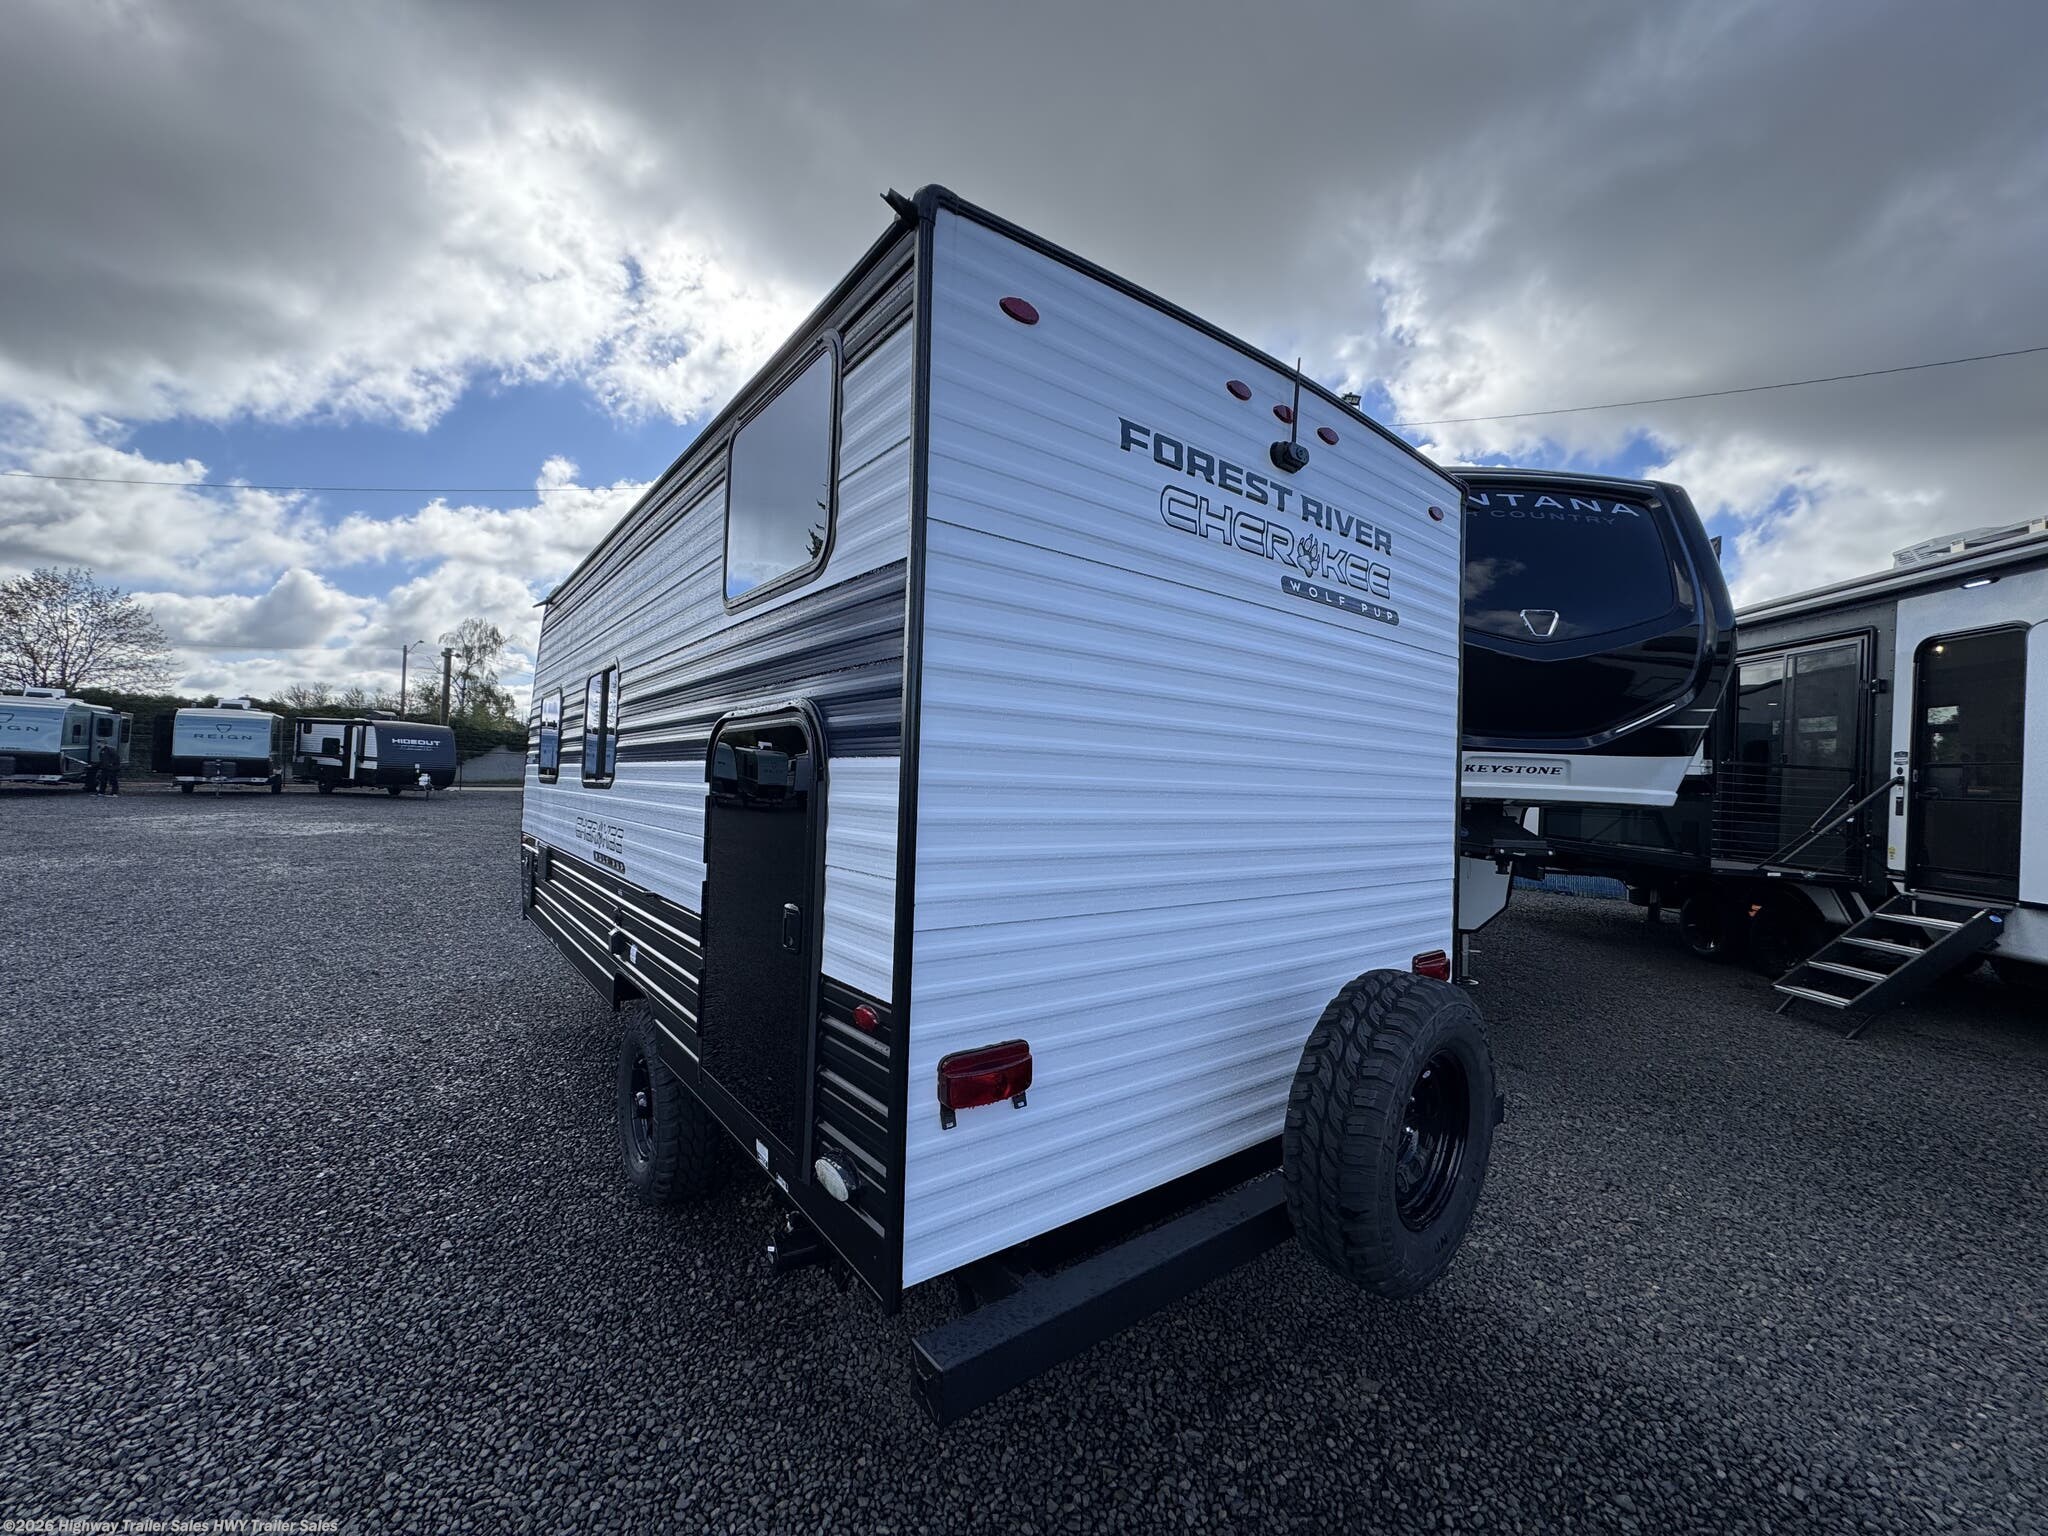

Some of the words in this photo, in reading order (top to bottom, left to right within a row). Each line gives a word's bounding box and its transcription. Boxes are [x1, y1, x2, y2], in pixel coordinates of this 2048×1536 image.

[1118, 416, 1293, 512] FOREST
[1301, 494, 1392, 556] RIVER
[1490, 510, 1616, 526] COUNTRY
[1290, 580, 1345, 606] WOLF
[1361, 603, 1393, 621] PUP
[392, 738, 441, 746] HIDEOUT
[1464, 764, 1563, 775] KEYSTONE
